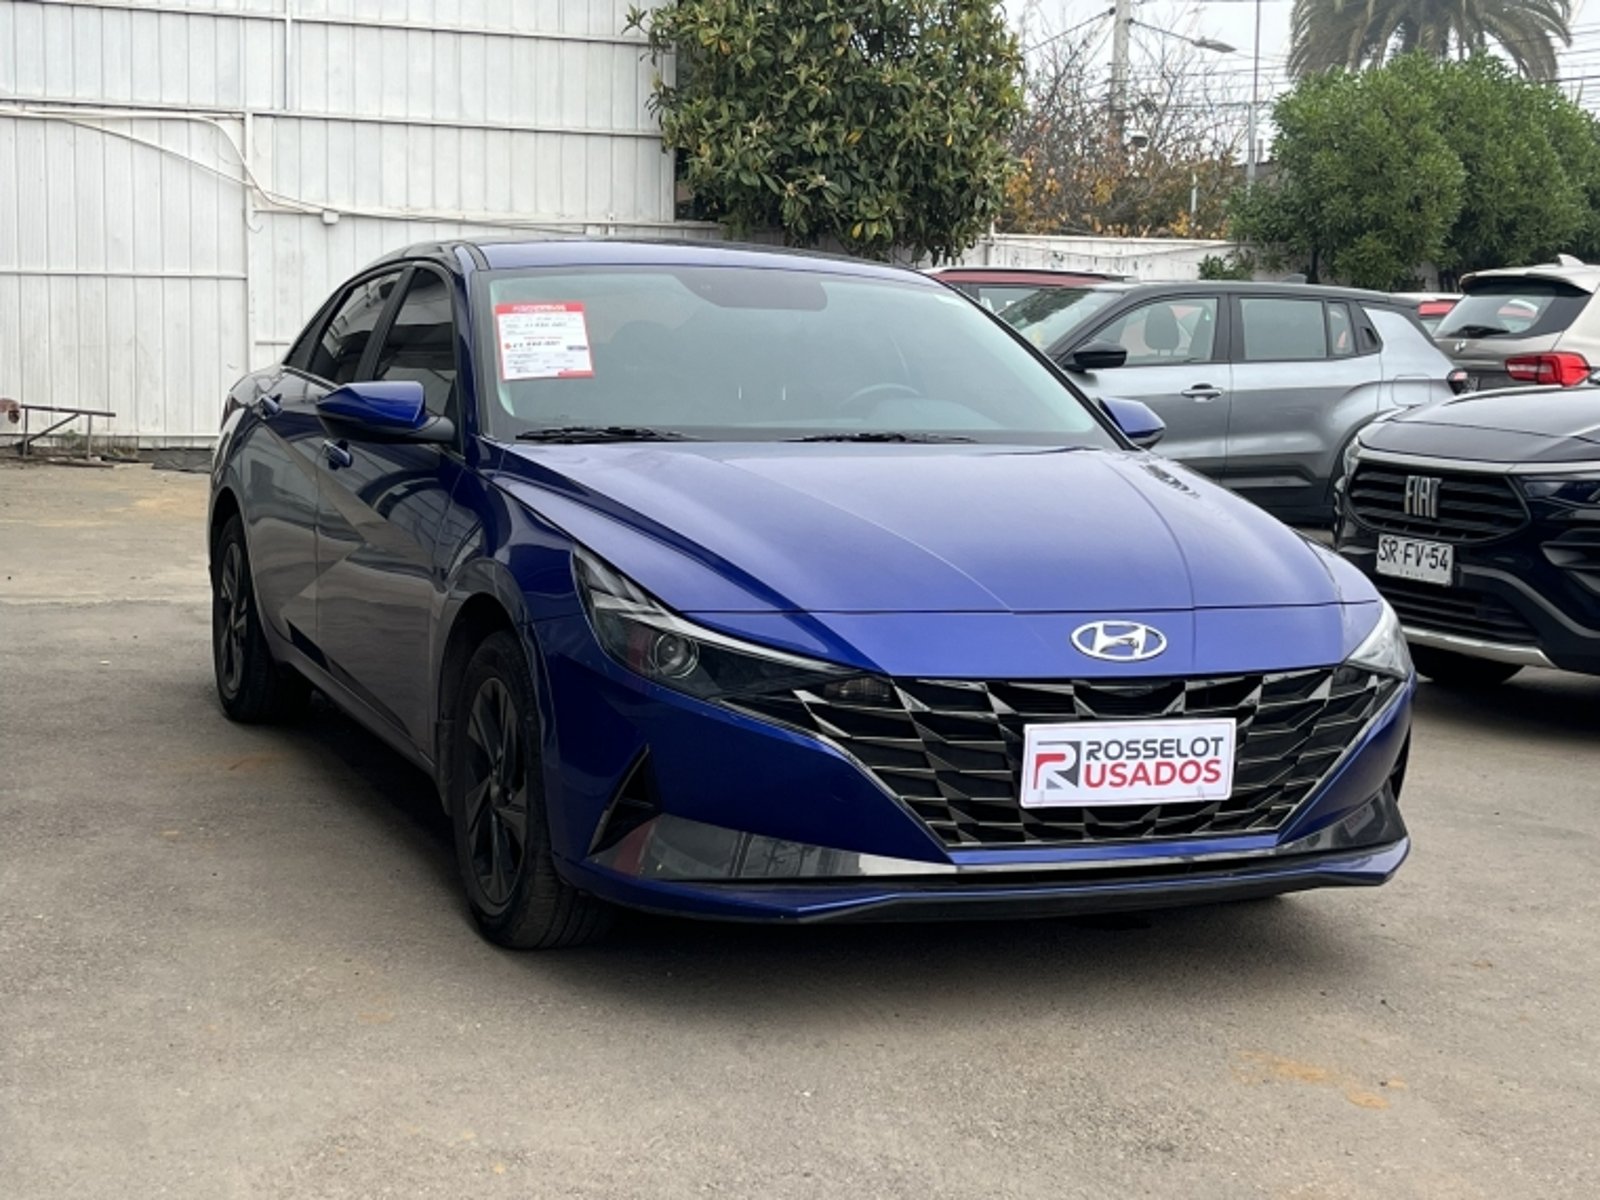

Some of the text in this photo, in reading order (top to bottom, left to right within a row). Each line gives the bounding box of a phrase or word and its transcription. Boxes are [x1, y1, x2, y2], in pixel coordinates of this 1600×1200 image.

[1404, 475, 1443, 519] FIAT
[1085, 737, 1224, 761] ROSSELOT
[1084, 759, 1222, 789] USADOS
